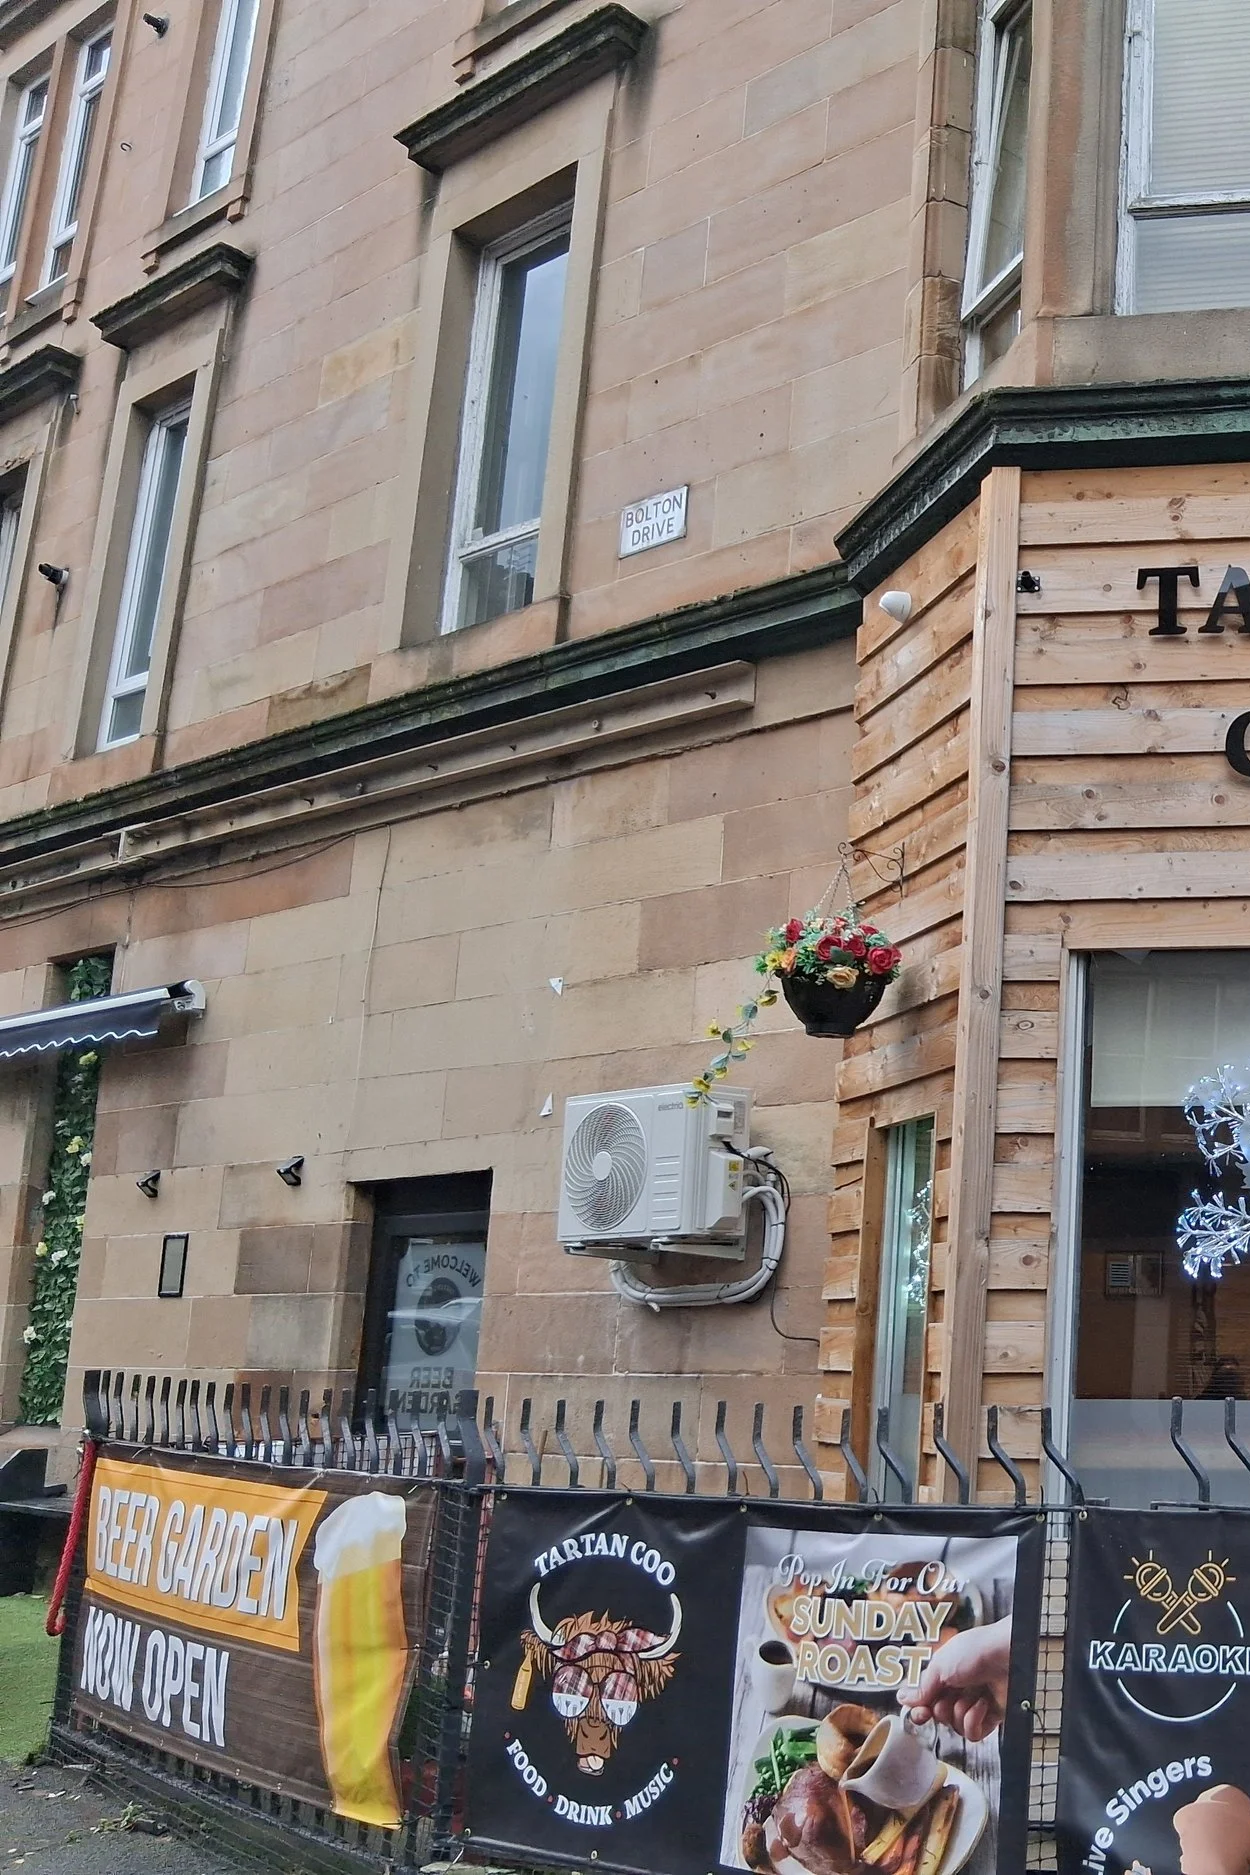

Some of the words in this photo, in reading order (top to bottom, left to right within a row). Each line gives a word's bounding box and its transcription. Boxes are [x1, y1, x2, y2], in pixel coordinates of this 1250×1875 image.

[625, 492, 683, 529] BOLTON
[631, 517, 675, 547] DRIVE
[95, 1486, 159, 1587] BEER
[156, 1499, 299, 1620] GARDEN
[533, 1532, 630, 1578] TARTAN
[630, 1541, 676, 1586] COO
[778, 1554, 822, 1596] Pop
[824, 1558, 856, 1595] In
[861, 1558, 913, 1594] For
[916, 1560, 971, 1596] Our
[789, 1595, 953, 1643] SUNDAY
[80, 1605, 141, 1711] NOW
[141, 1629, 230, 1748] OPEN
[796, 1640, 933, 1688] ROAST
[506, 1739, 548, 1797] FOOD
[553, 1794, 613, 1826] DRINK
[623, 1762, 675, 1820] MUSIC
[1082, 1827, 1114, 1875] ive
[1105, 1755, 1213, 1826] Singers
